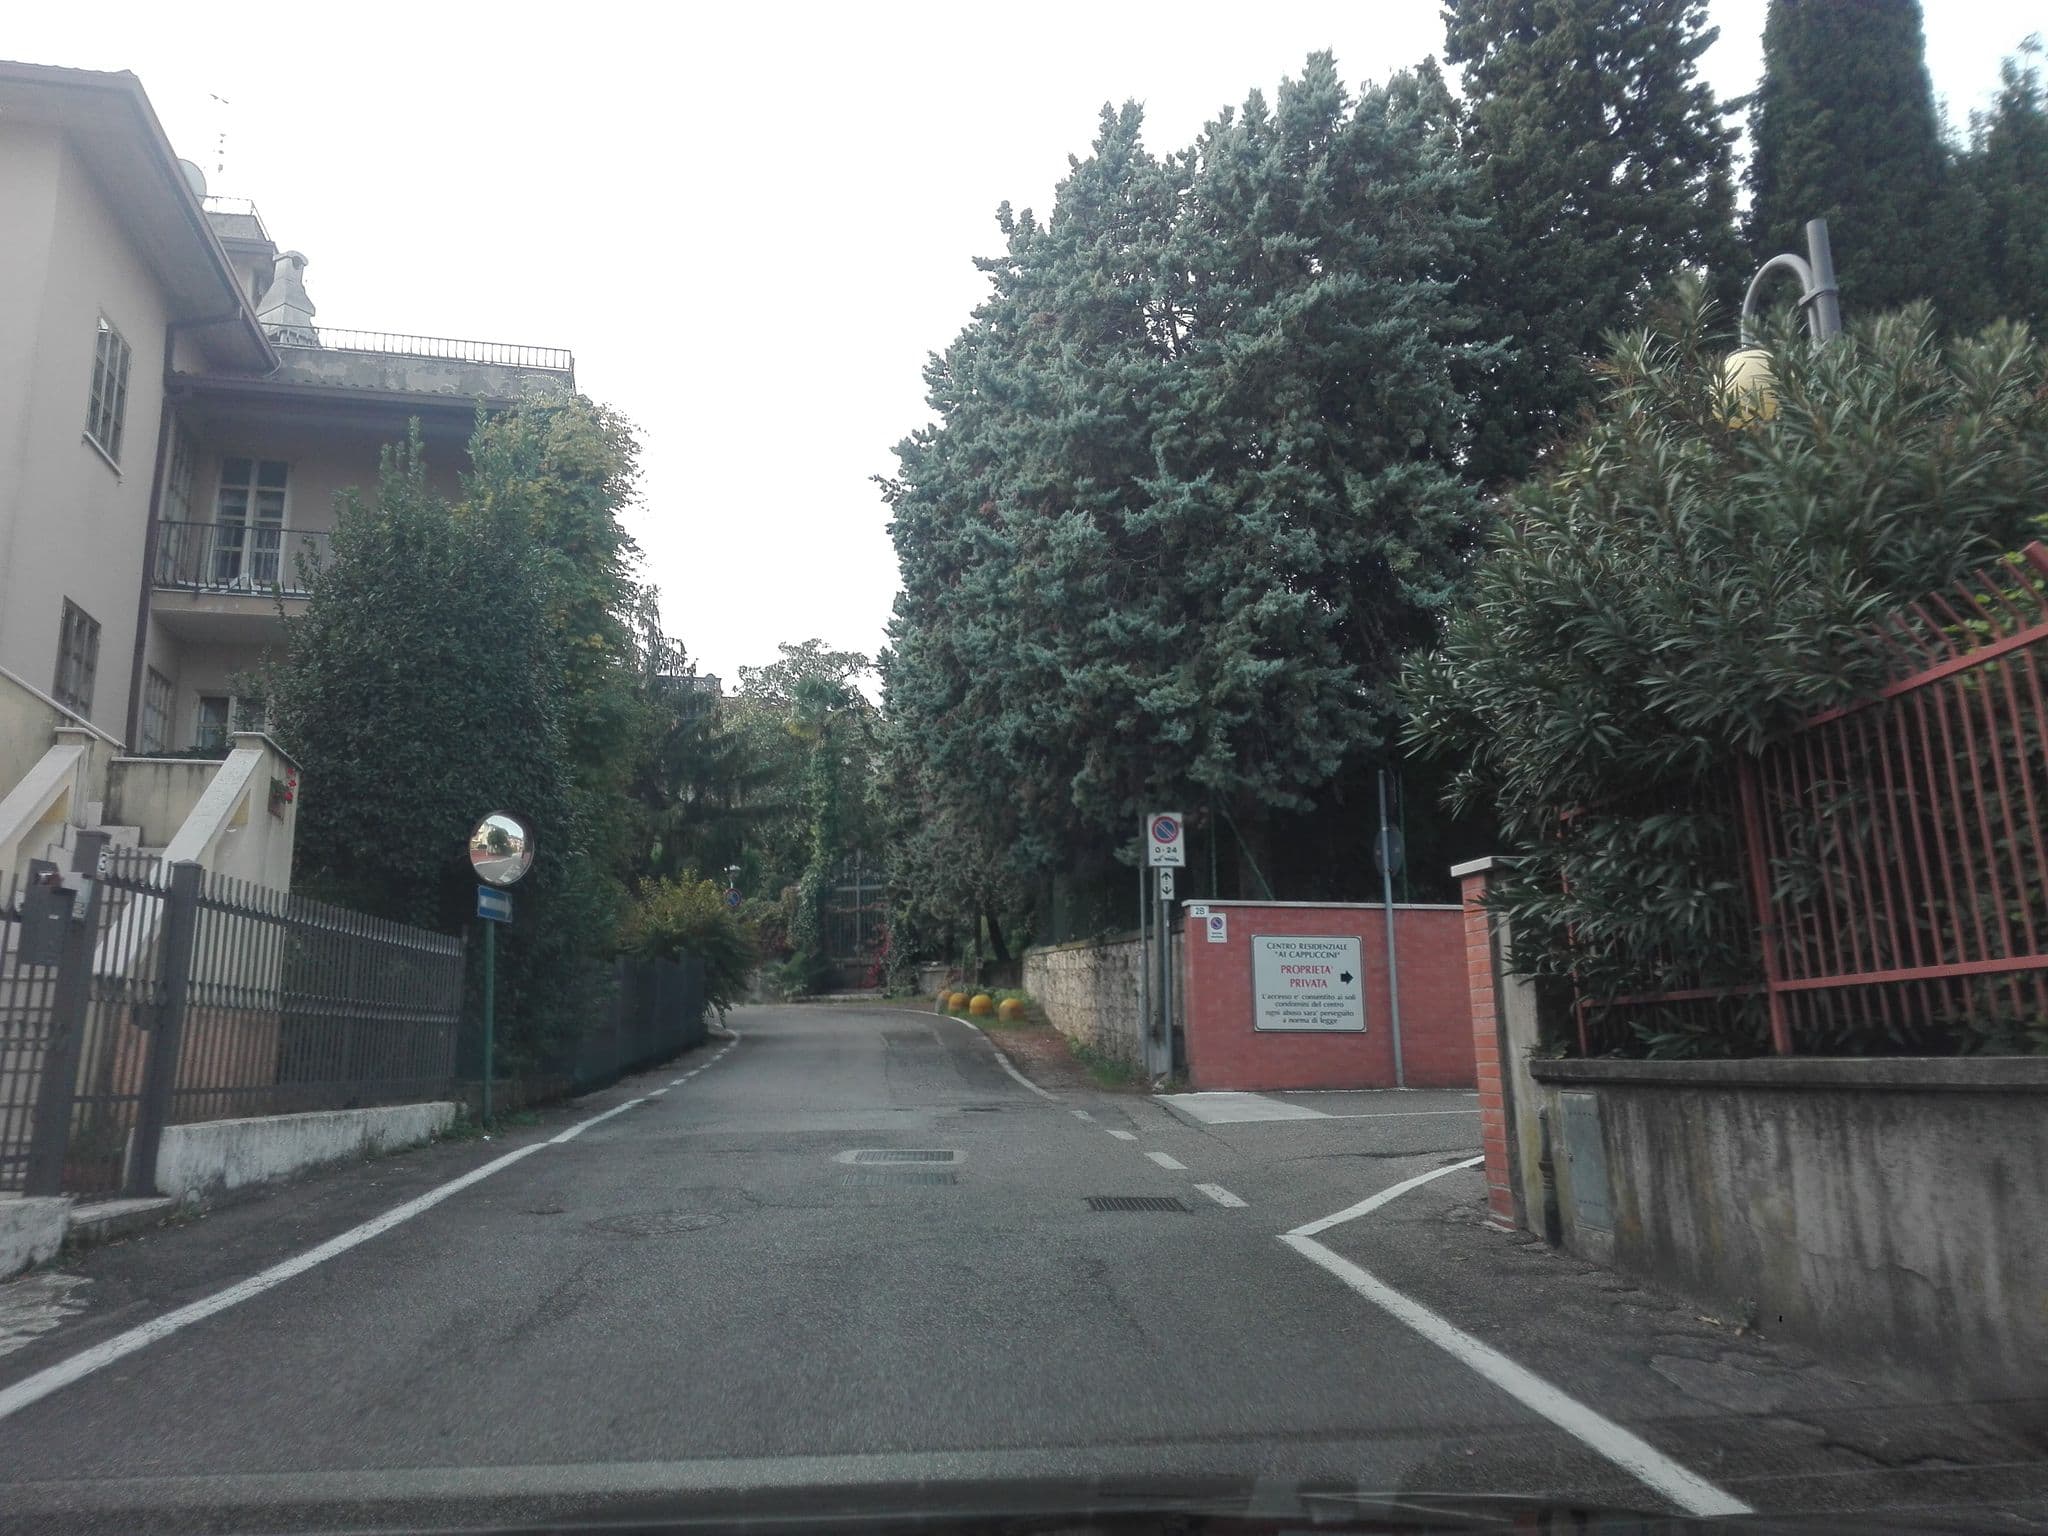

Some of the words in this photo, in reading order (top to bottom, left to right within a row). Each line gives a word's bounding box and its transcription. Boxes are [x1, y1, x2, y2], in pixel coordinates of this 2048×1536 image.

[1266, 942, 1297, 950] CENTRO
[1299, 942, 1348, 951] RESIDENZIALE
[1289, 978, 1328, 988] PRIVATA
